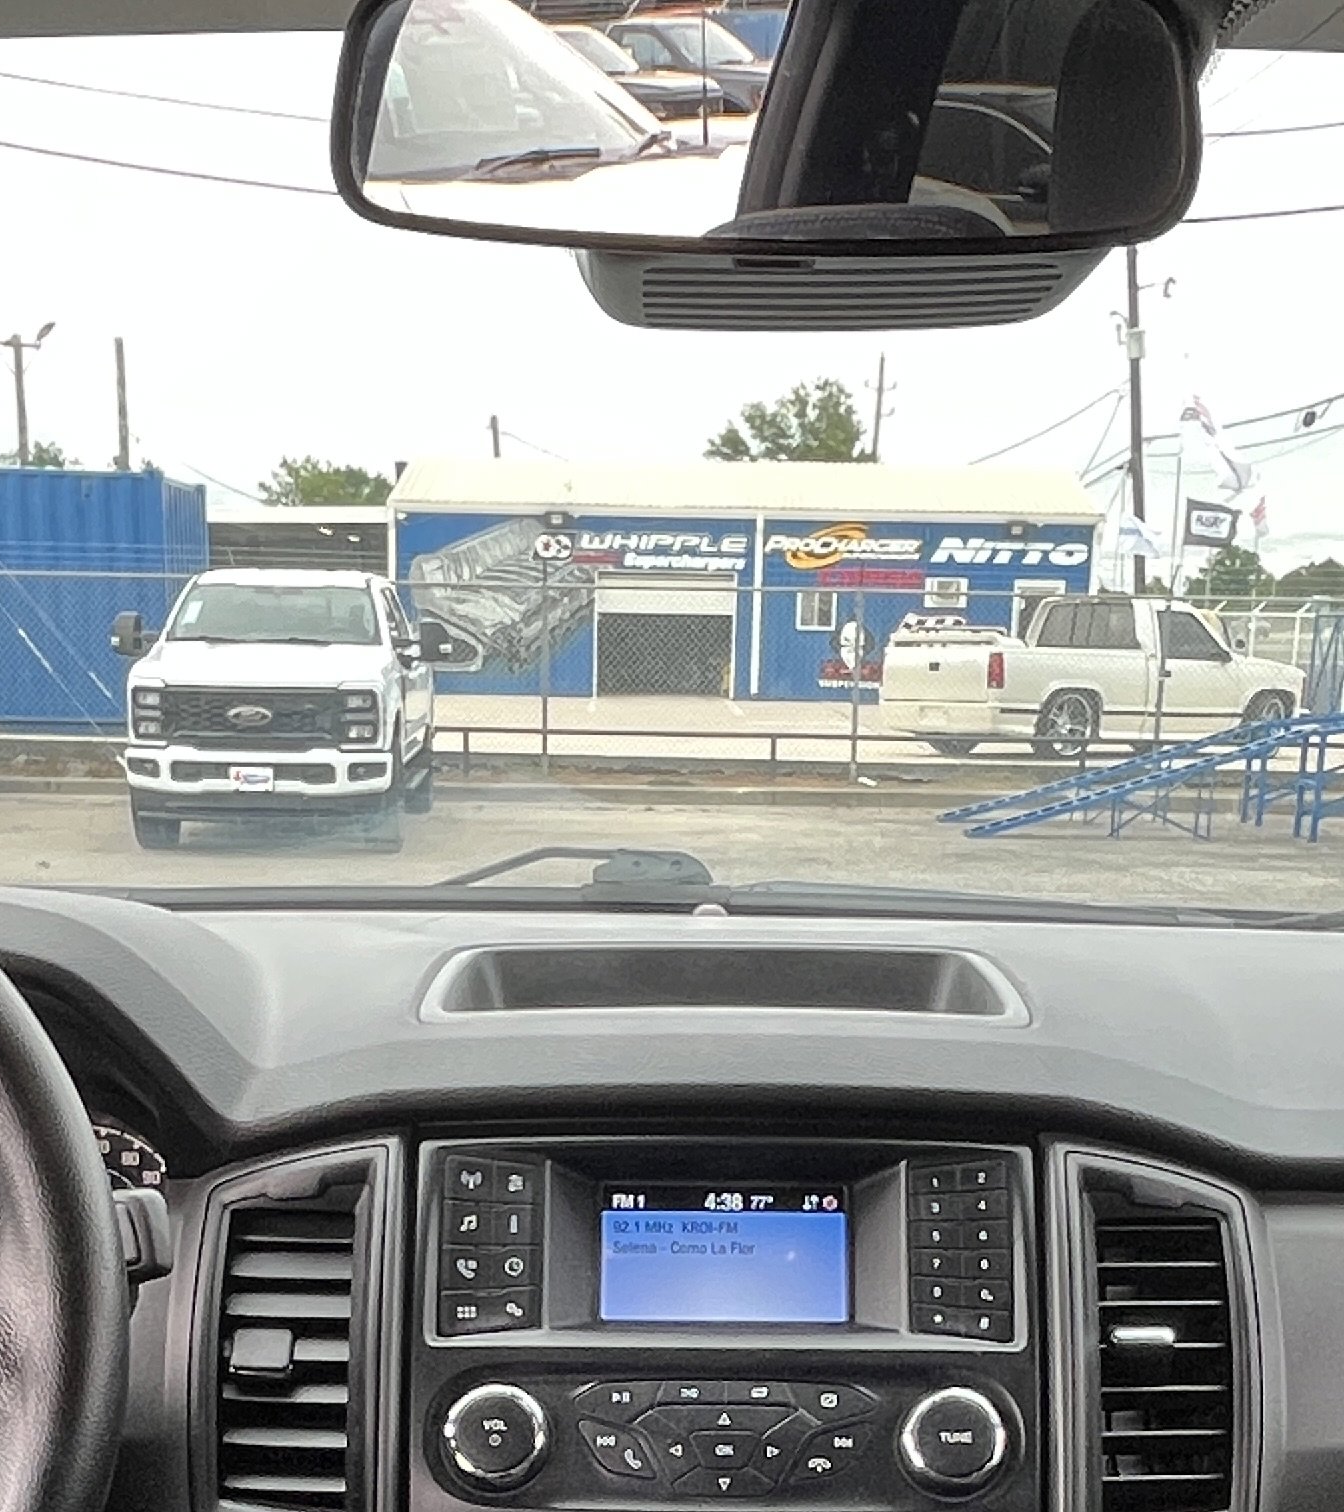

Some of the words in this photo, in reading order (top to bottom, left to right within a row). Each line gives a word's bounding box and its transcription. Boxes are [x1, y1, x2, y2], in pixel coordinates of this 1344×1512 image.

[580, 533, 748, 552] WHIPPLE
[611, 1193, 634, 1209] FM
[636, 1193, 647, 1209] 1
[703, 1191, 744, 1211] 4:38
[613, 1220, 641, 1234] 92.1
[644, 1220, 674, 1234] MHz
[612, 1240, 657, 1255] Selena
[670, 1240, 707, 1255] Como
[710, 1240, 727, 1255] La
[730, 1240, 757, 1255] Flor
[482, 1418, 508, 1431] VOL
[938, 1430, 973, 1444] TUNE
